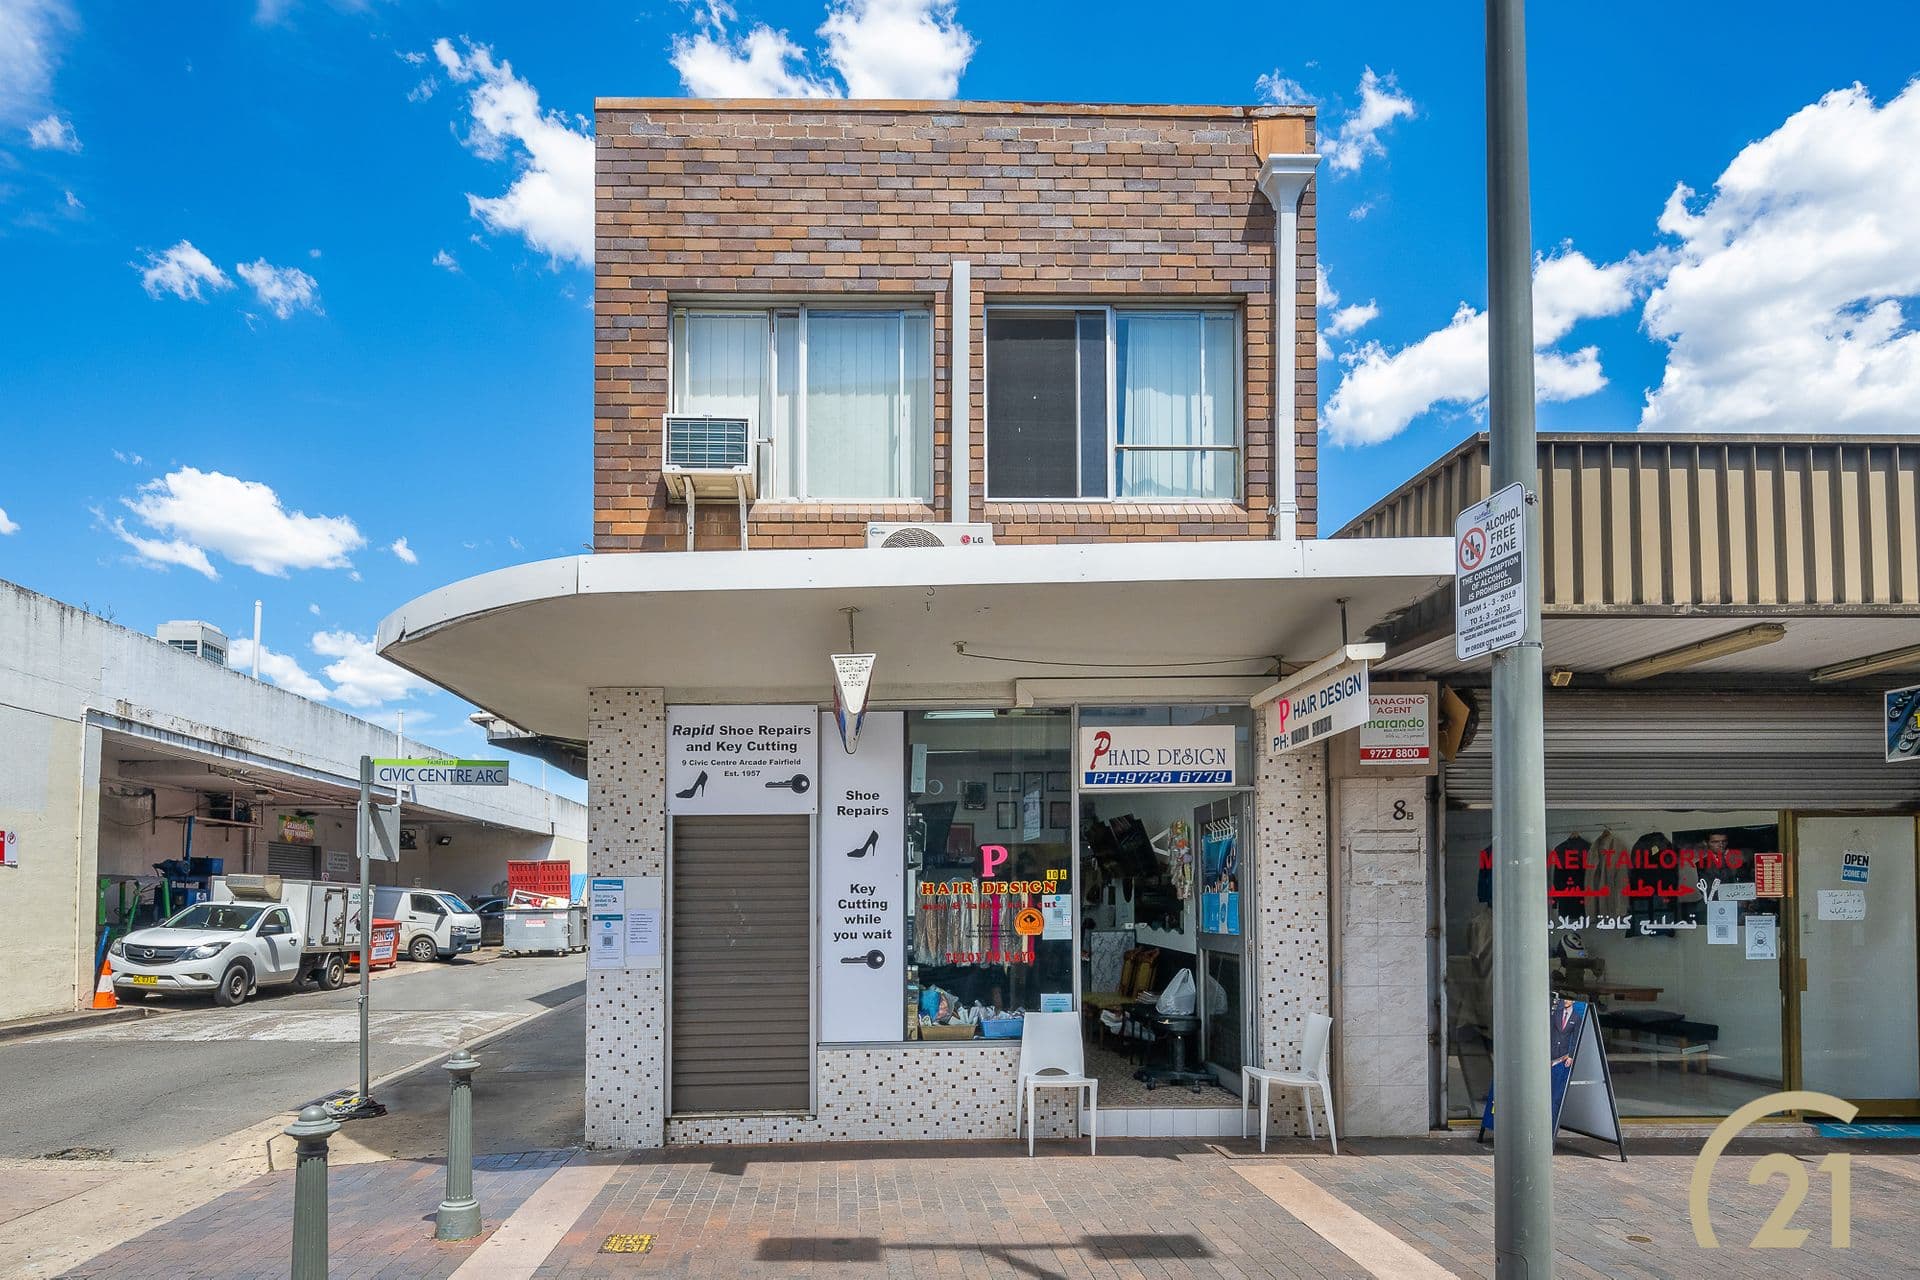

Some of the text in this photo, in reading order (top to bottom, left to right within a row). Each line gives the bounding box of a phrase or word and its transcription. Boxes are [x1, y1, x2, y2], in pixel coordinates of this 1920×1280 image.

[1485, 506, 1520, 533] ALCOHOL
[972, 536, 984, 544] LG
[1490, 522, 1516, 545] FREE
[1489, 537, 1516, 559] ZONE
[1461, 555, 1519, 586] THE CONSUMPTION
[1471, 570, 1508, 591] OF ALCOHOL
[1468, 577, 1512, 601] IS PROHIBITED
[1464, 605, 1482, 617] FROM
[1470, 617, 1477, 626] TO
[1470, 641, 1485, 651] ORDER
[1495, 630, 1517, 642] MANAGER
[1279, 698, 1290, 733] P
[1293, 694, 1317, 720] HAIR
[1320, 672, 1362, 709] DESIGN
[1376, 706, 1412, 714] AGENT
[1363, 717, 1425, 728] marando
[672, 724, 811, 738] Rapid Shoe Repairs
[686, 741, 798, 753] and Key Cutting
[1090, 730, 1226, 770] P HAIR DESIGN
[1369, 748, 1420, 758] 9727 8800
[769, 758, 801, 766] Fairfield
[380, 768, 503, 783] CIVIC CENTRE ARC
[1179, 771, 1226, 783] 6779
[846, 790, 880, 800] Shoe
[837, 805, 889, 818] Repairs
[980, 845, 1009, 878] P
[1479, 849, 1744, 870] MAEL TAILORING
[1844, 853, 1870, 866] OPEN
[1843, 869, 1868, 879] COME IN
[850, 883, 876, 896] Key
[921, 880, 1057, 895] HAIR DESIGN
[838, 899, 888, 911] Cutting
[844, 913, 881, 924] while
[1596, 914, 1633, 930] كافة
[833, 929, 893, 942] you wait
